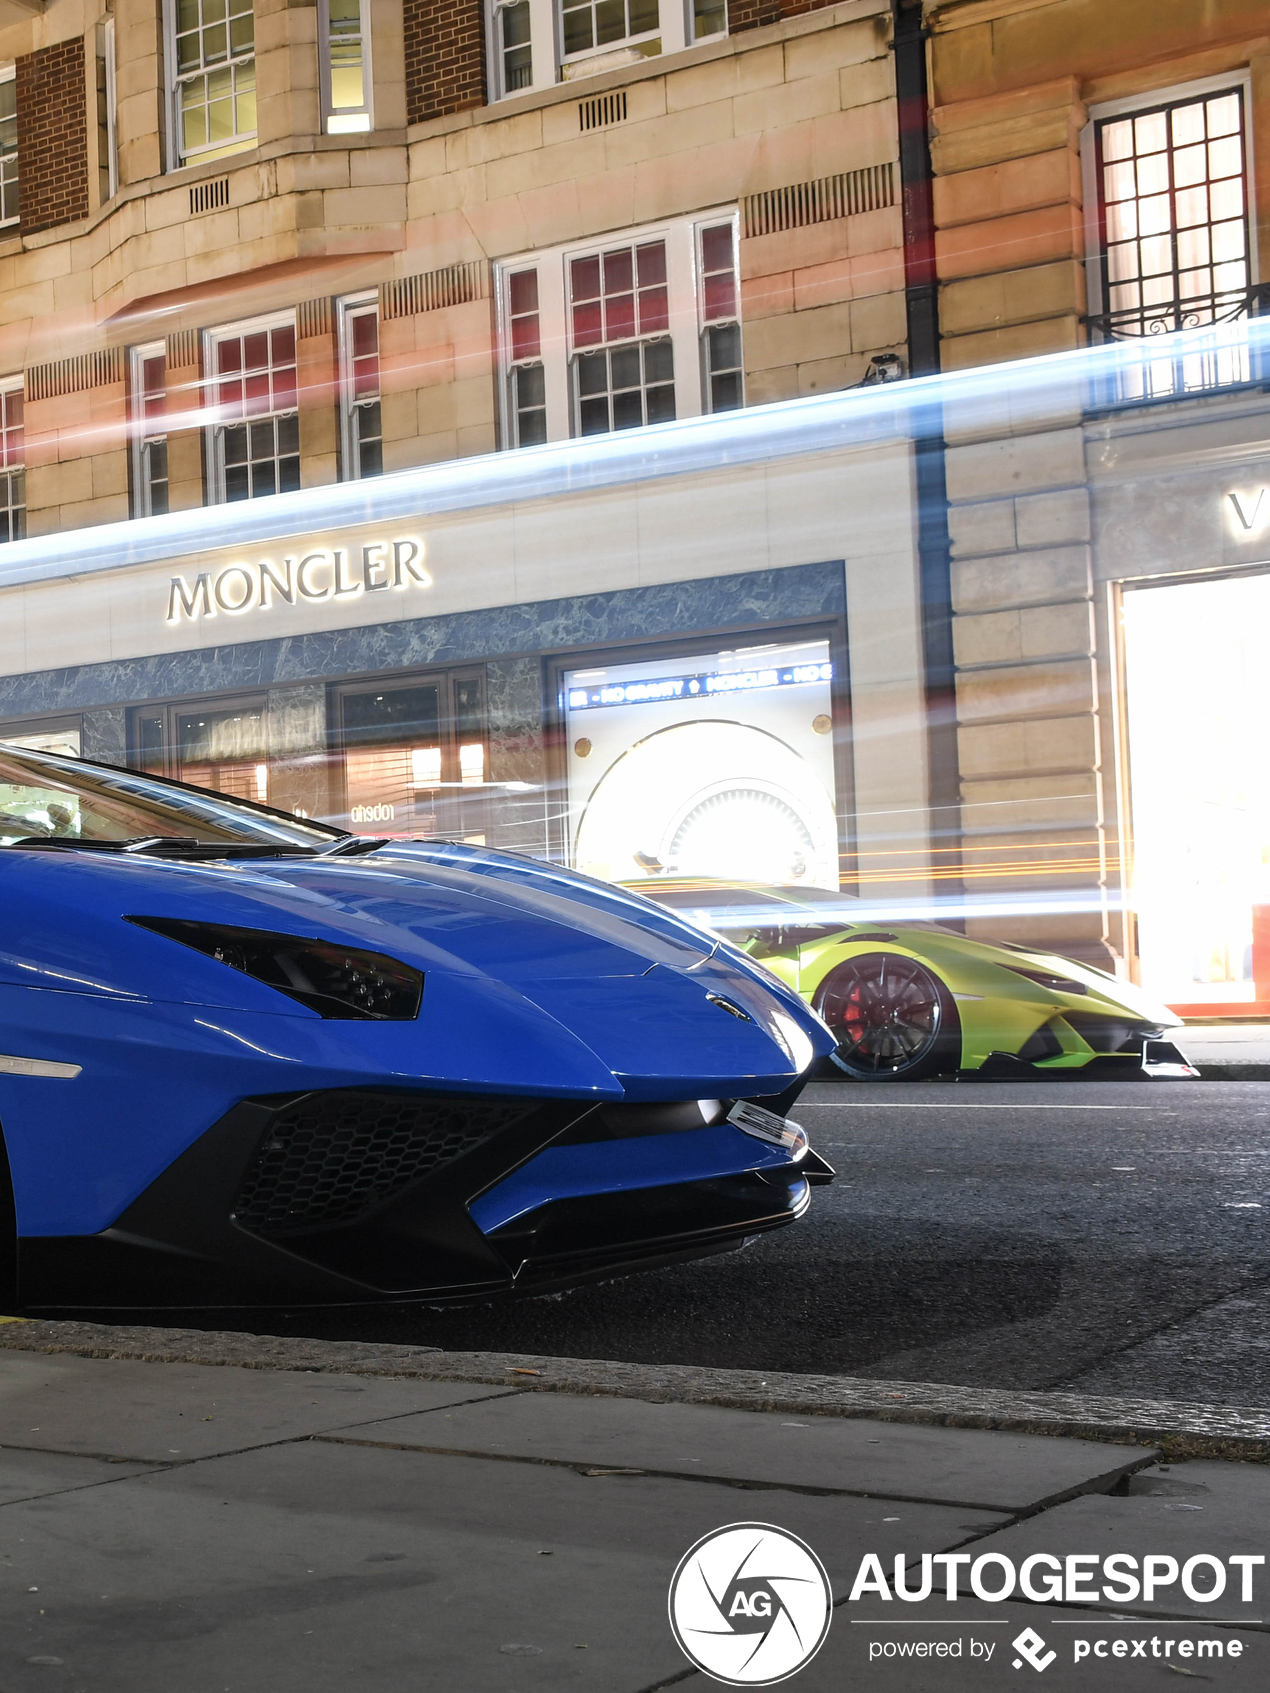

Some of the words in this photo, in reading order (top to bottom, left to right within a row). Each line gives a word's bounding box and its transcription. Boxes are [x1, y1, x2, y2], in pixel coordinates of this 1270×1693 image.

[166, 540, 425, 621] MONCLER
[601, 687, 625, 703] NO
[625, 680, 684, 701] GRAVITY
[707, 670, 779, 692] MONCLER
